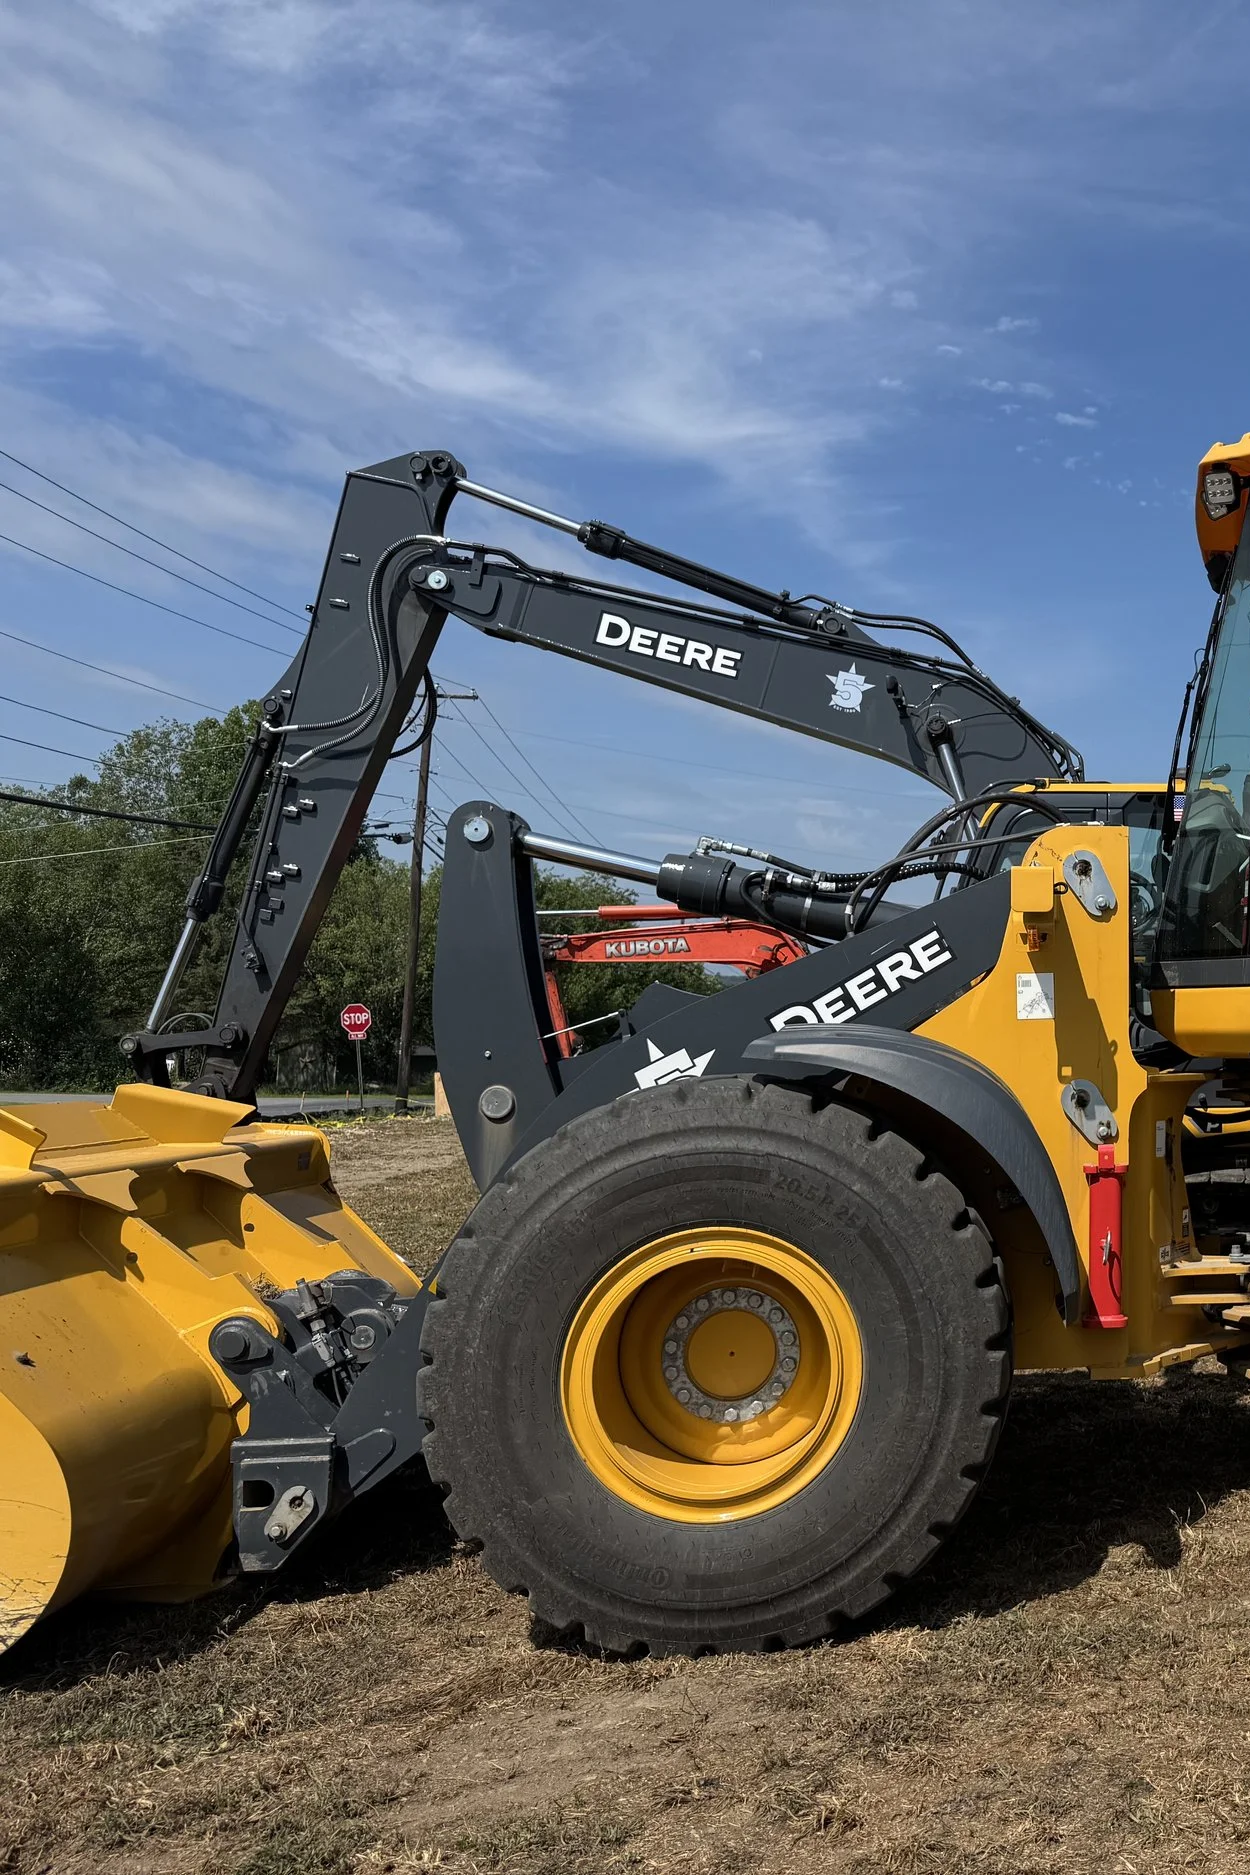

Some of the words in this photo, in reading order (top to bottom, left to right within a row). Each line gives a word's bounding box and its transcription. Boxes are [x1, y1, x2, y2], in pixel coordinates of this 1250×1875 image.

[595, 612, 742, 678] DEERE
[604, 937, 691, 959] KUBOTA
[343, 1012, 370, 1026] STOP
